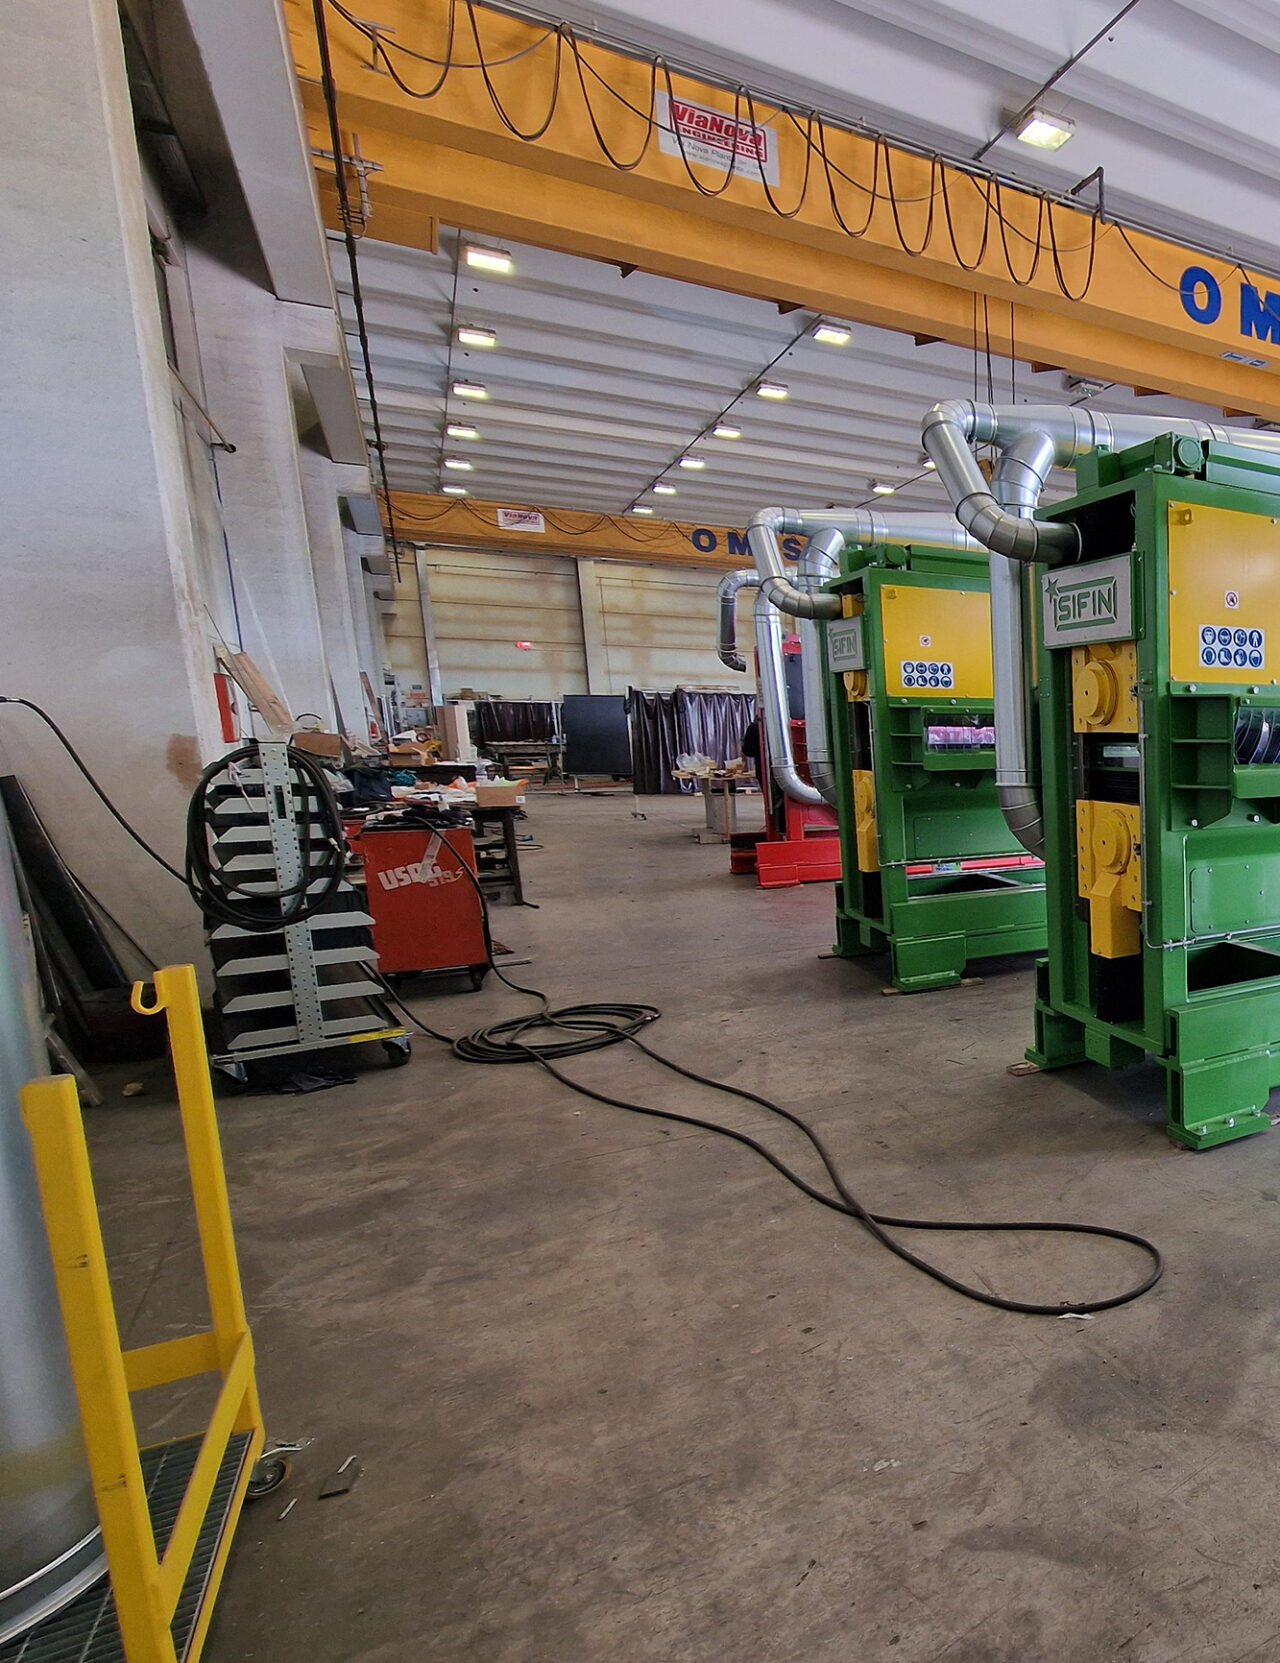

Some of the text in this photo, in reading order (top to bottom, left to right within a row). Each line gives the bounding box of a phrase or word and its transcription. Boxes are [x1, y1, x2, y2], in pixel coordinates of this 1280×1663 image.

[674, 104, 763, 146] ViaNova
[691, 528, 802, 561] OMS
[1058, 586, 1113, 622] SIFIN
